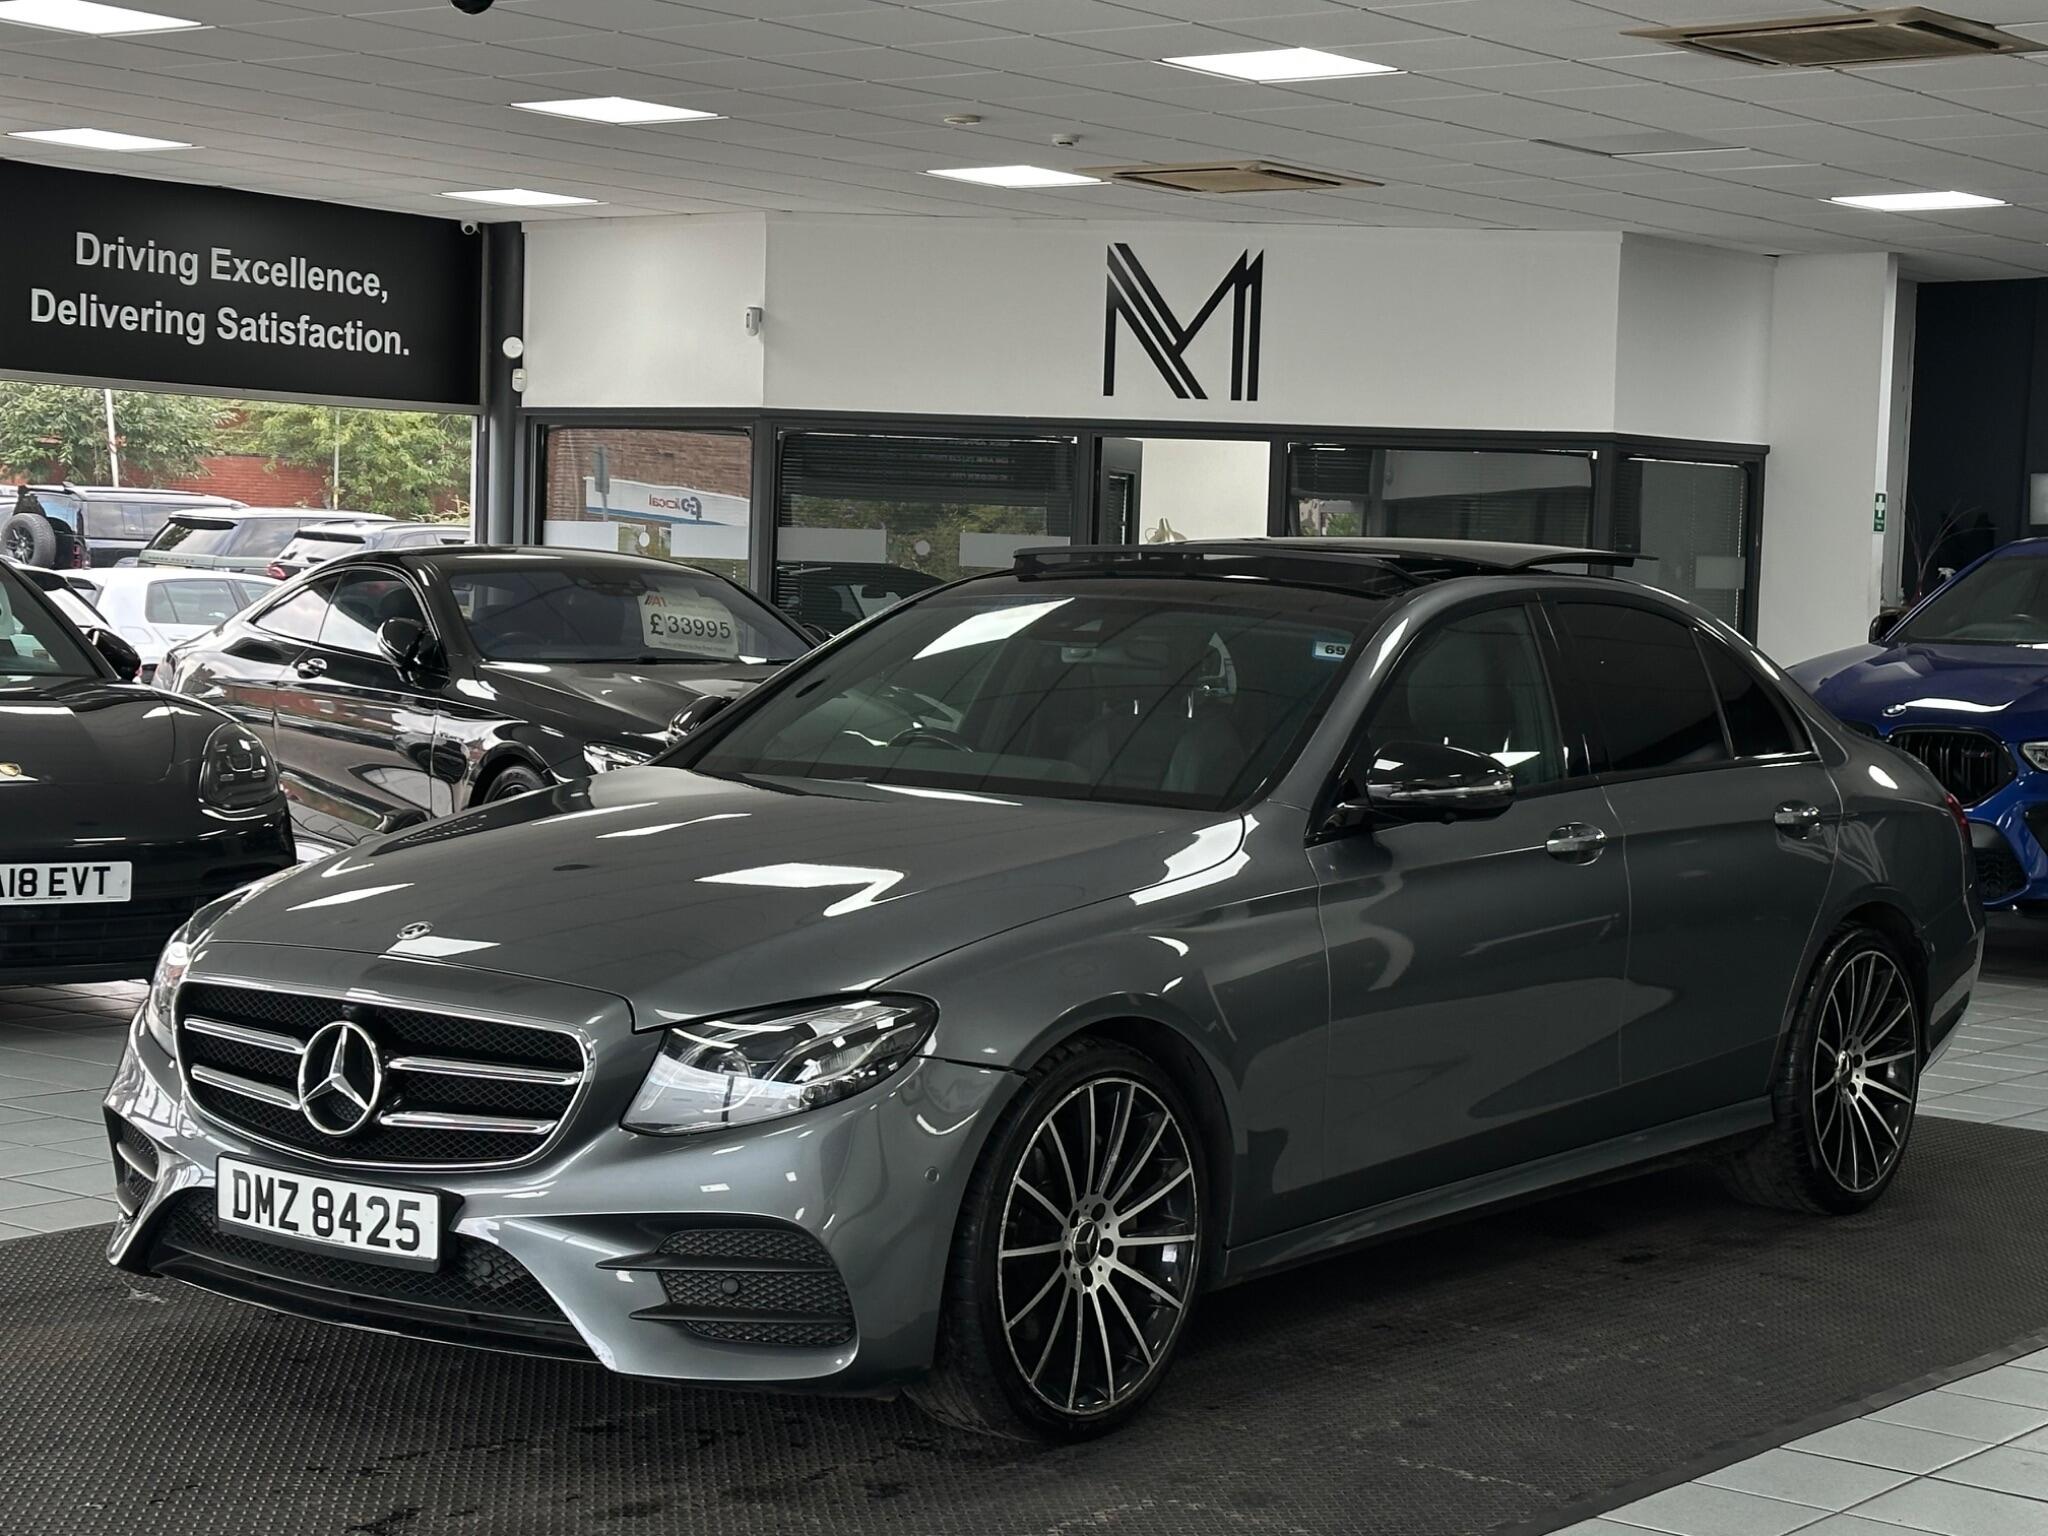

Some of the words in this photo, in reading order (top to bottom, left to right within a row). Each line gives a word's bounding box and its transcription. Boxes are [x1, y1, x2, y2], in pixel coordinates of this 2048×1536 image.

[75, 231, 199, 286] Driving
[210, 247, 389, 304] Excellence,
[30, 287, 206, 346] Delivering
[216, 306, 411, 356] Satisfaction.
[1324, 644, 1346, 655] 69
[0, 867, 38, 898] 18
[48, 865, 112, 897] EVT
[232, 1168, 299, 1232] DMZ
[312, 1186, 420, 1252] 8425
